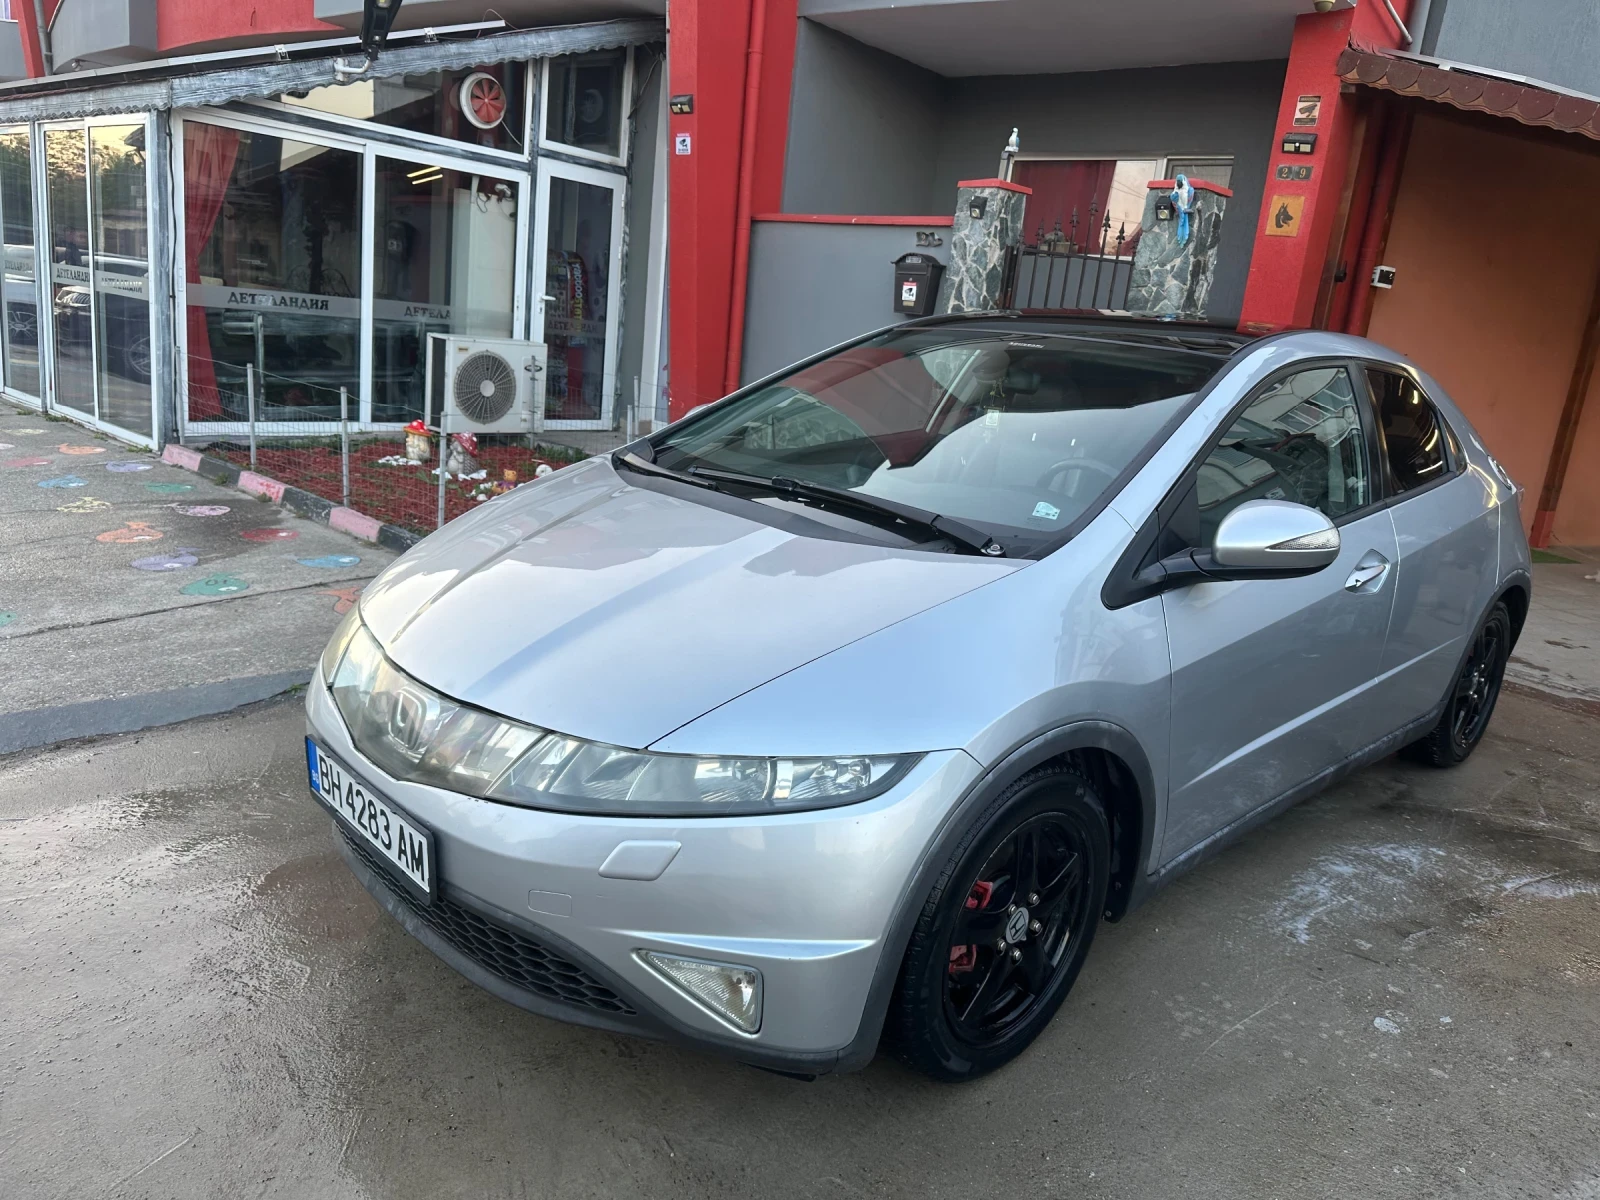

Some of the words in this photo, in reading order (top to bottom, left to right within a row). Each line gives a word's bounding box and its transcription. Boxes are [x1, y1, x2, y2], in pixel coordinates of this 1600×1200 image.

[1281, 167, 1307, 178] 29
[318, 753, 343, 808] BH
[346, 781, 392, 851] 4283
[397, 823, 425, 882] AM
